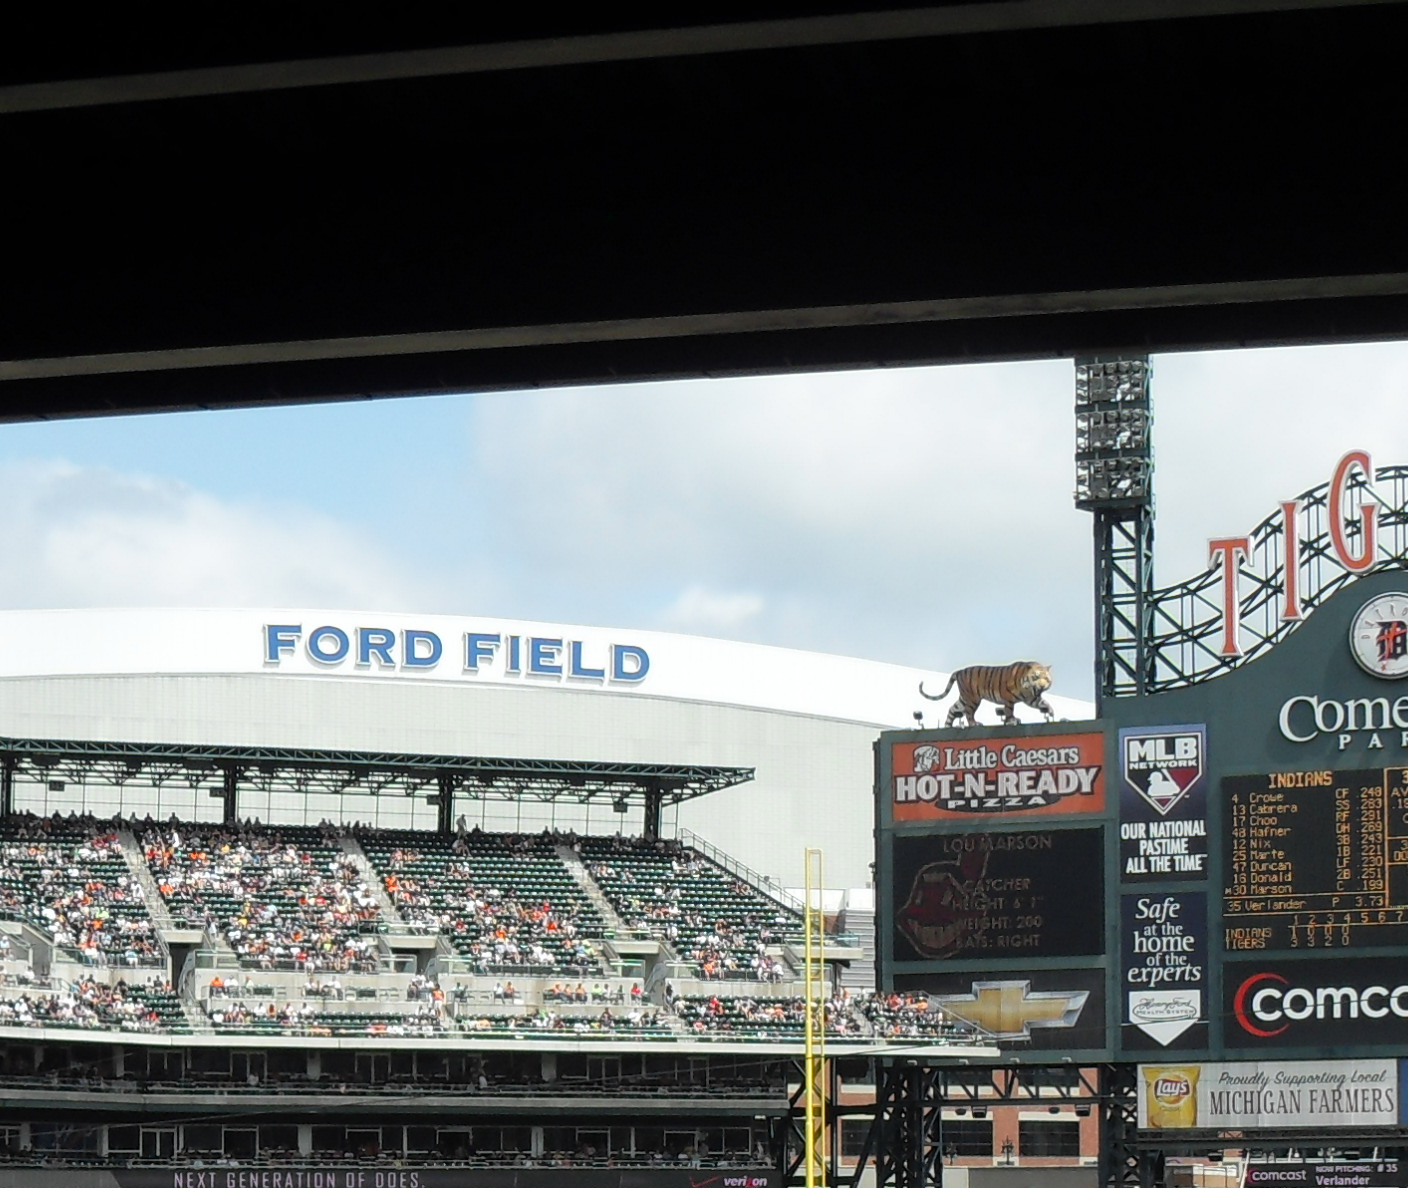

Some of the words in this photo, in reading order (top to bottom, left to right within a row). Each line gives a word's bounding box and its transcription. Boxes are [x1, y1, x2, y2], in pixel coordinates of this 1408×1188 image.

[262, 623, 442, 667] FORD
[462, 631, 651, 684] FIELD
[1129, 738, 1197, 761] MLB
[945, 746, 997, 770] Little
[1001, 745, 1079, 767] Caesars
[1129, 759, 1197, 769] NETWORK
[895, 766, 1100, 801] HOT-N-READY
[1268, 771, 1333, 788] INDIANS
[947, 797, 1047, 809] PIZZA
[1250, 793, 1284, 802] Crowe
[1250, 804, 1298, 814] Cabrera
[1250, 816, 1278, 826] Choo
[1121, 822, 1146, 839] OUR
[1149, 820, 1206, 837] NATIONAL
[1250, 827, 1291, 837] Hafner
[1139, 838, 1188, 855] PASTIME
[1250, 840, 1272, 849] Nix
[1251, 851, 1285, 860] Marte
[1126, 857, 1148, 873] ALL
[1150, 856, 1172, 873] THE
[1251, 862, 1292, 872] Duncan
[1251, 872, 1292, 883] Donald
[1251, 885, 1292, 894] Marson
[1135, 898, 1180, 923] Safe
[1244, 900, 1307, 911] Verlander
[1144, 924, 1159, 937] at
[1162, 922, 1183, 936] the
[1225, 928, 1272, 940] INDIANS
[1134, 931, 1195, 953] home
[1225, 938, 1266, 950] TIGERS
[1147, 953, 1162, 967] of
[1165, 953, 1187, 966] the
[1127, 963, 1201, 987] experts
[1218, 1071, 1270, 1092] Proudly
[1274, 1070, 1347, 1091] Supporting
[1351, 1068, 1387, 1084] Local
[1209, 1089, 1302, 1116] MICHIGAN
[1309, 1088, 1395, 1114] FARMERS
[174, 1172, 217, 1188] NEXT
[226, 1172, 336, 1188] GENERATION
[346, 1172, 366, 1188] OF
[723, 1175, 768, 1188] verizon
[1252, 1169, 1307, 1181] comcast
[1316, 1175, 1370, 1186] Verlander
